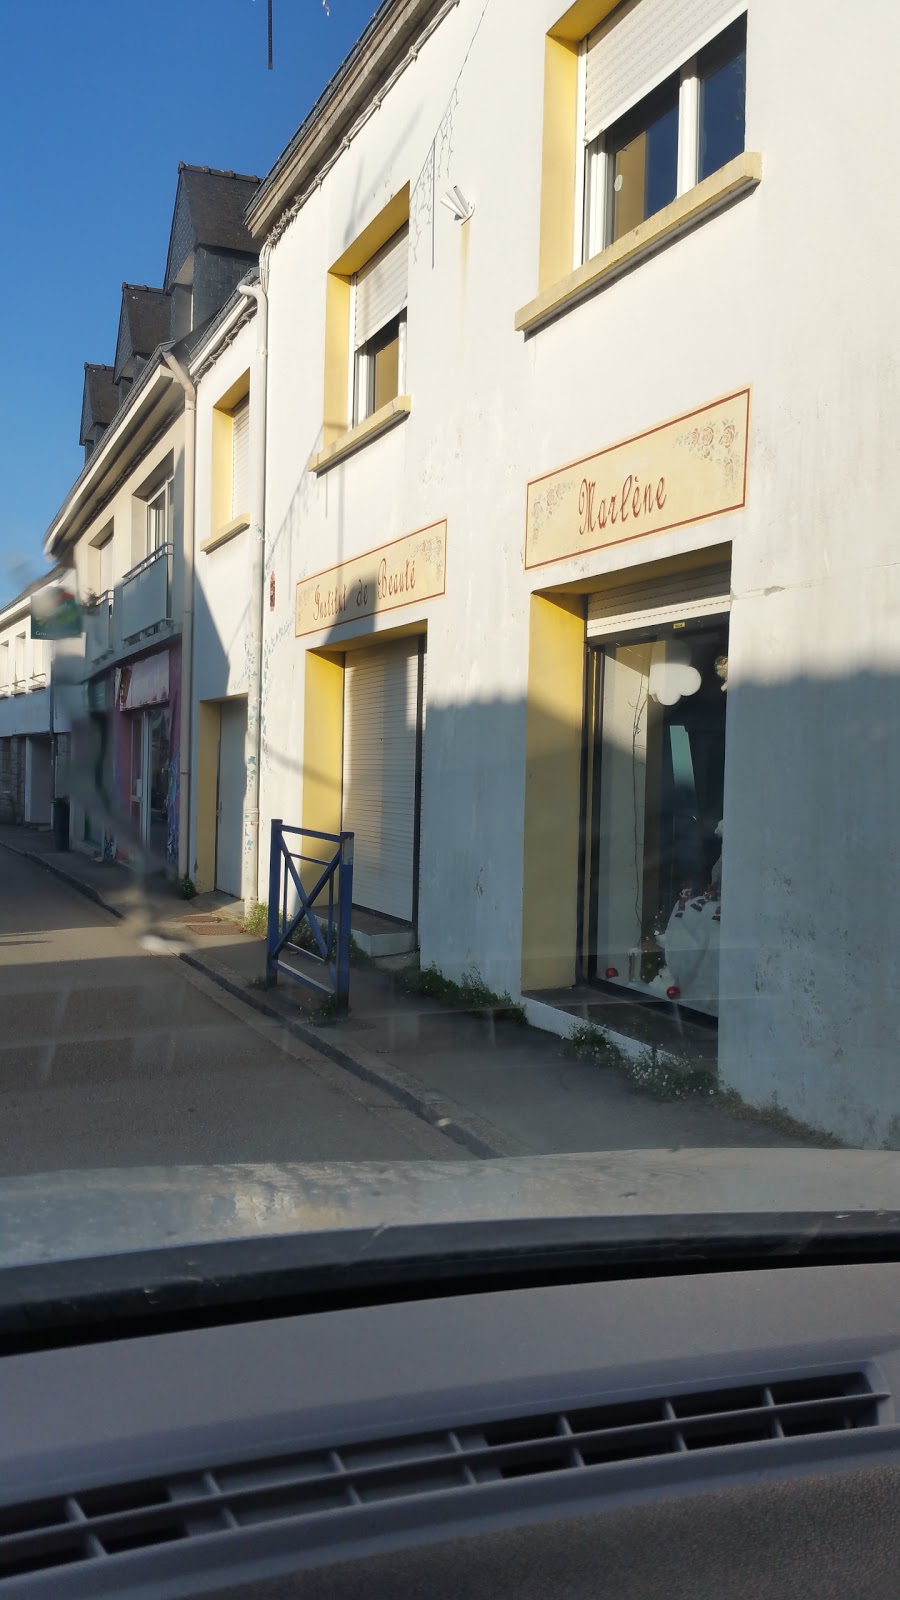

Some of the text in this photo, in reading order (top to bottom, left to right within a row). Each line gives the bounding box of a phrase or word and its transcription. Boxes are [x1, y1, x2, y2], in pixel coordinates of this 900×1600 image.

[578, 474, 668, 536] Marlène
[312, 557, 416, 621] Institut de Beauté
